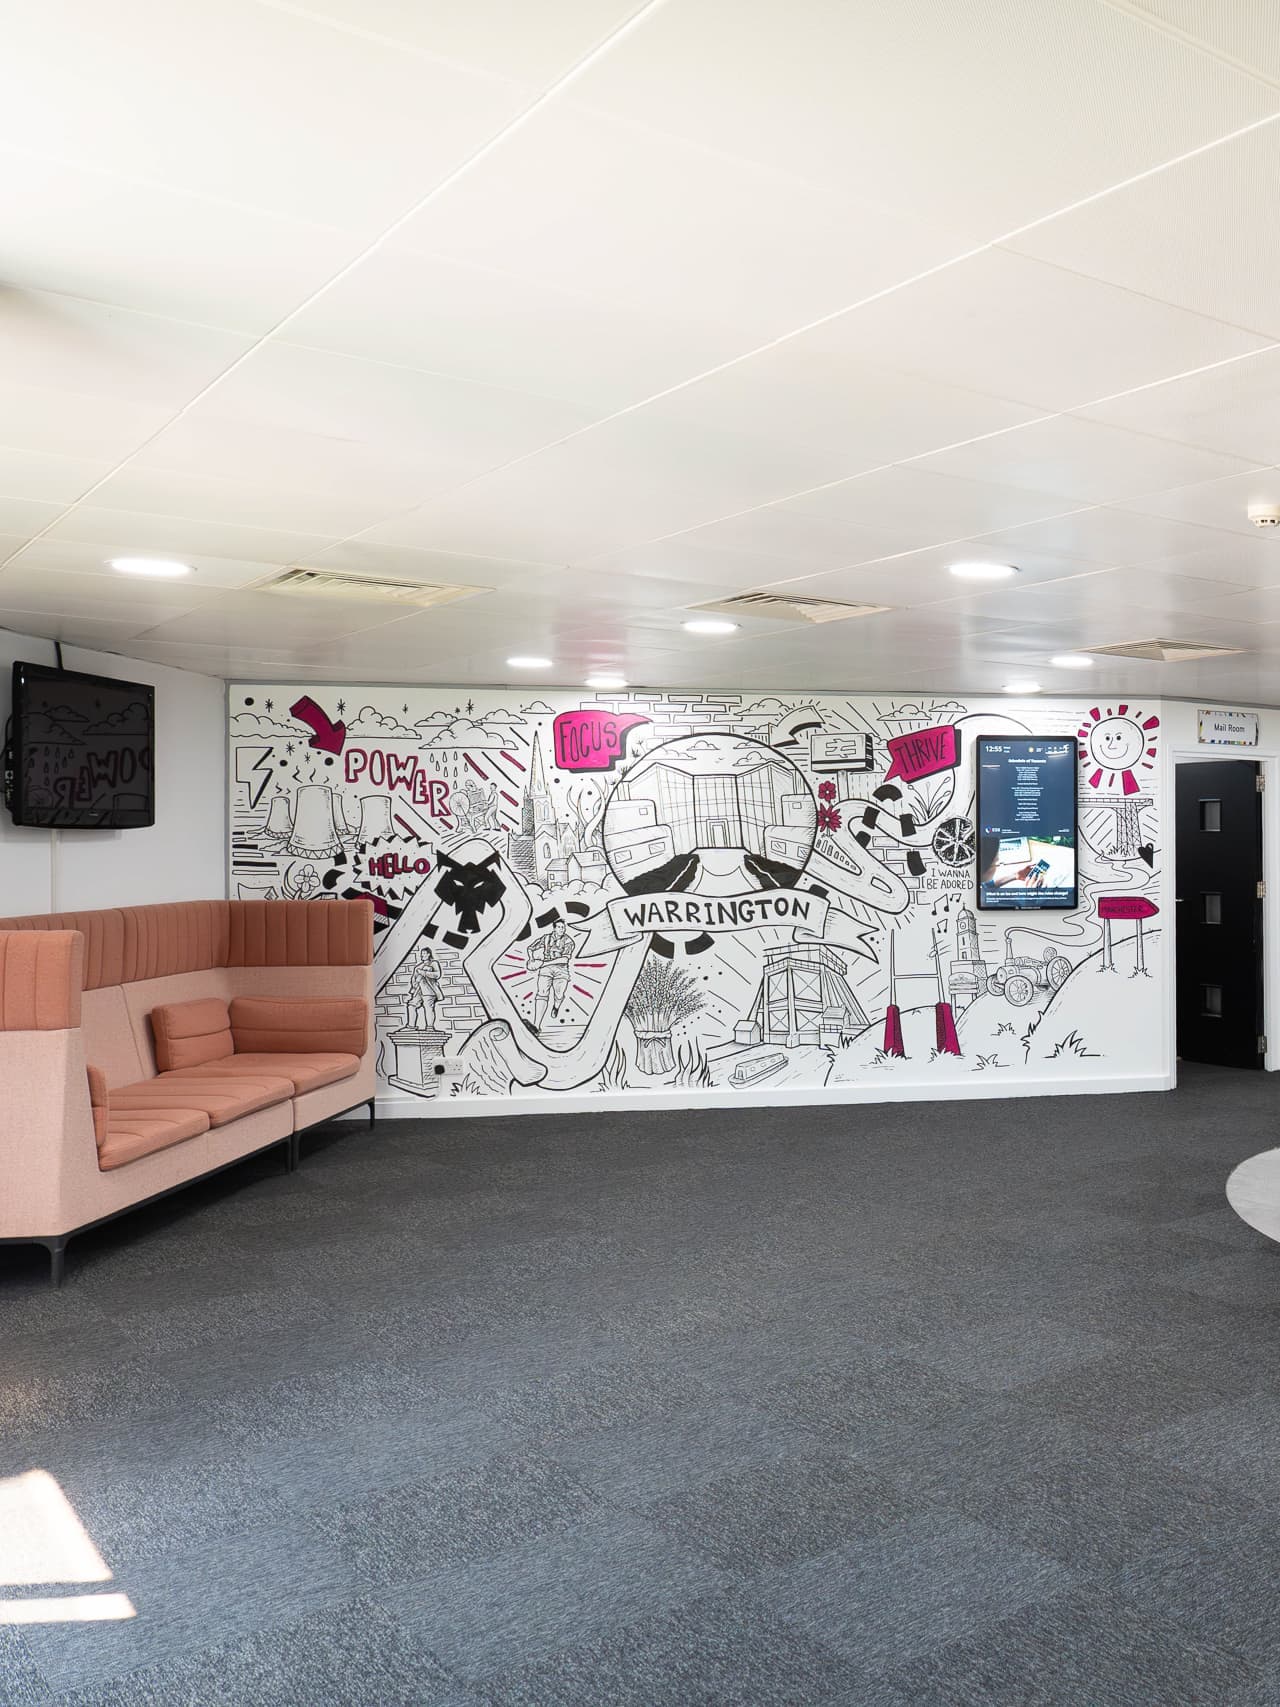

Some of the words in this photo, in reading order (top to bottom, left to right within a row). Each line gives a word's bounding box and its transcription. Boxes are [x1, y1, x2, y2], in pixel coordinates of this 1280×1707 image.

[560, 720, 618, 762] FOCUS
[1214, 723, 1227, 732] Mail
[1228, 724, 1245, 733] Room
[894, 731, 948, 774] THRIVE
[344, 748, 452, 818] POWER
[368, 852, 431, 879] HELLO
[931, 868, 936, 877] I
[938, 869, 971, 879] WANNA
[926, 878, 939, 890] BE
[941, 879, 974, 890] ADORED
[623, 897, 810, 927] WARRINGTON
